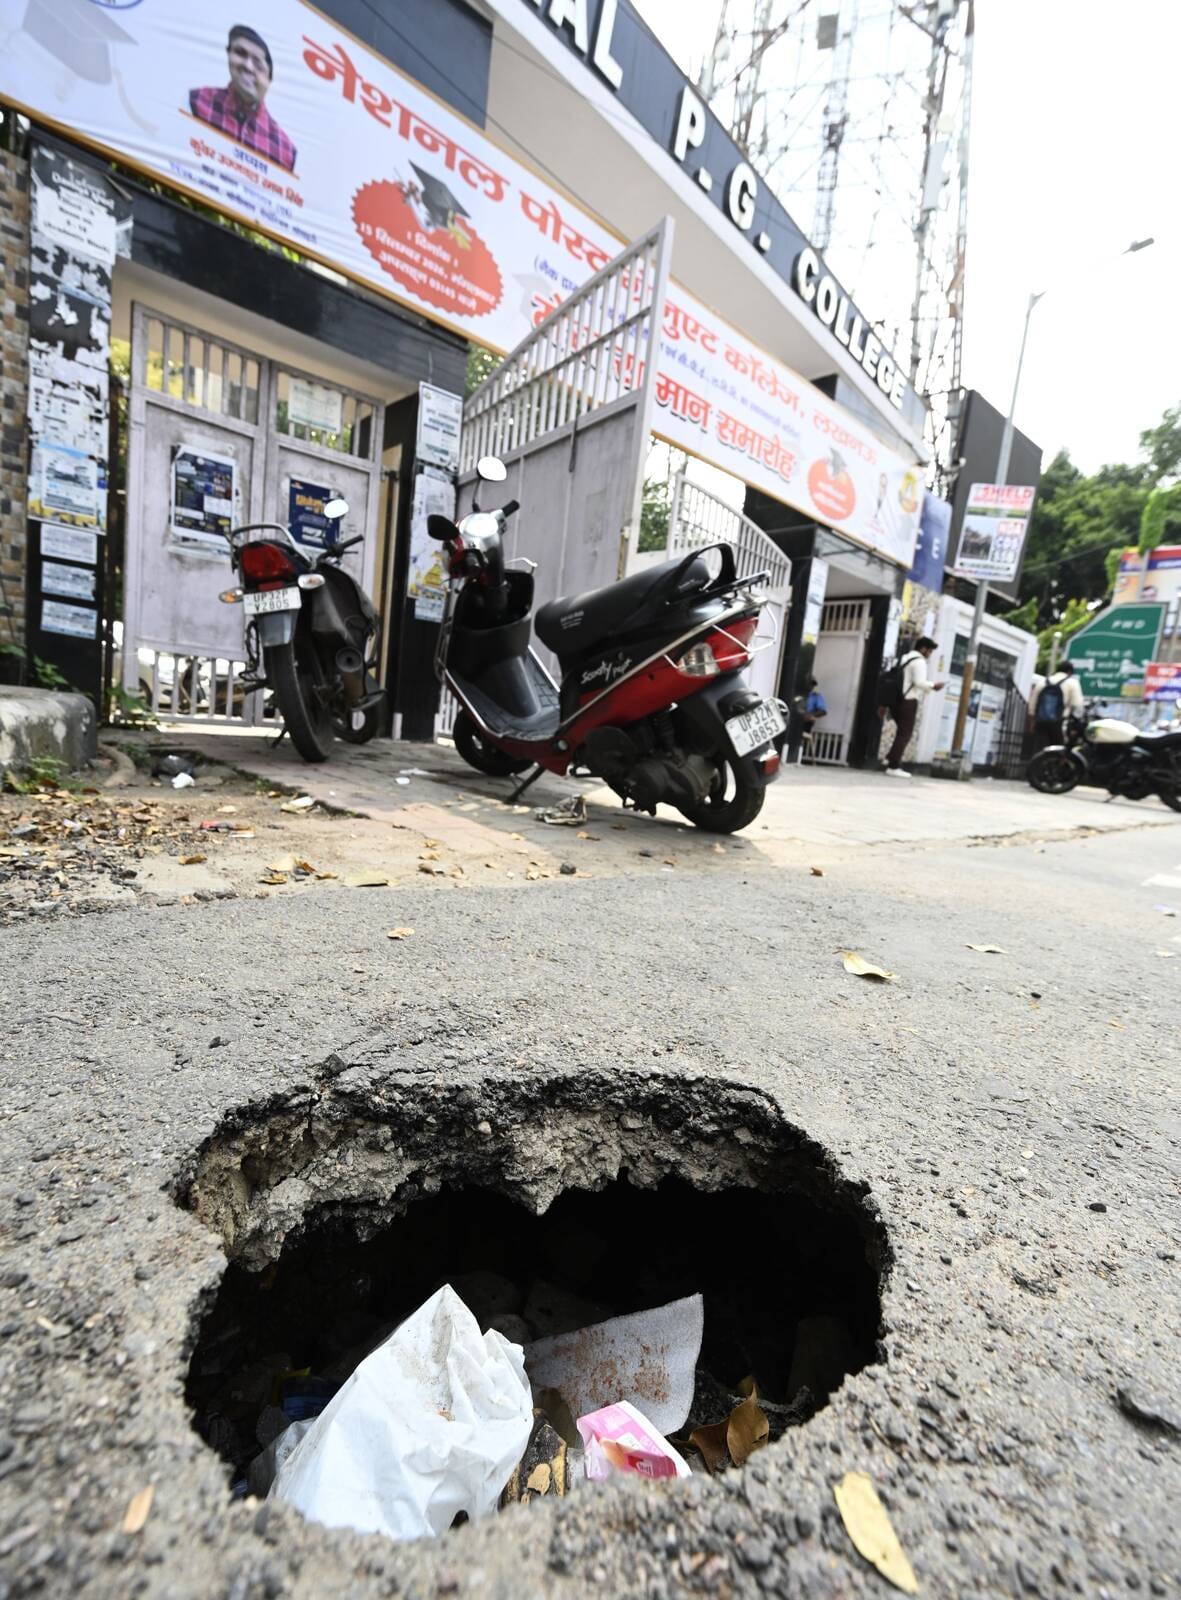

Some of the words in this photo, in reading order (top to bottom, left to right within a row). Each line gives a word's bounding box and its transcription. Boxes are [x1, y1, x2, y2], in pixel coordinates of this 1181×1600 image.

[301, 34, 509, 202] नेशनल
[533, 0, 623, 90] AL
[797, 247, 906, 403] COLLEGE
[748, 718, 780, 748] J8853
